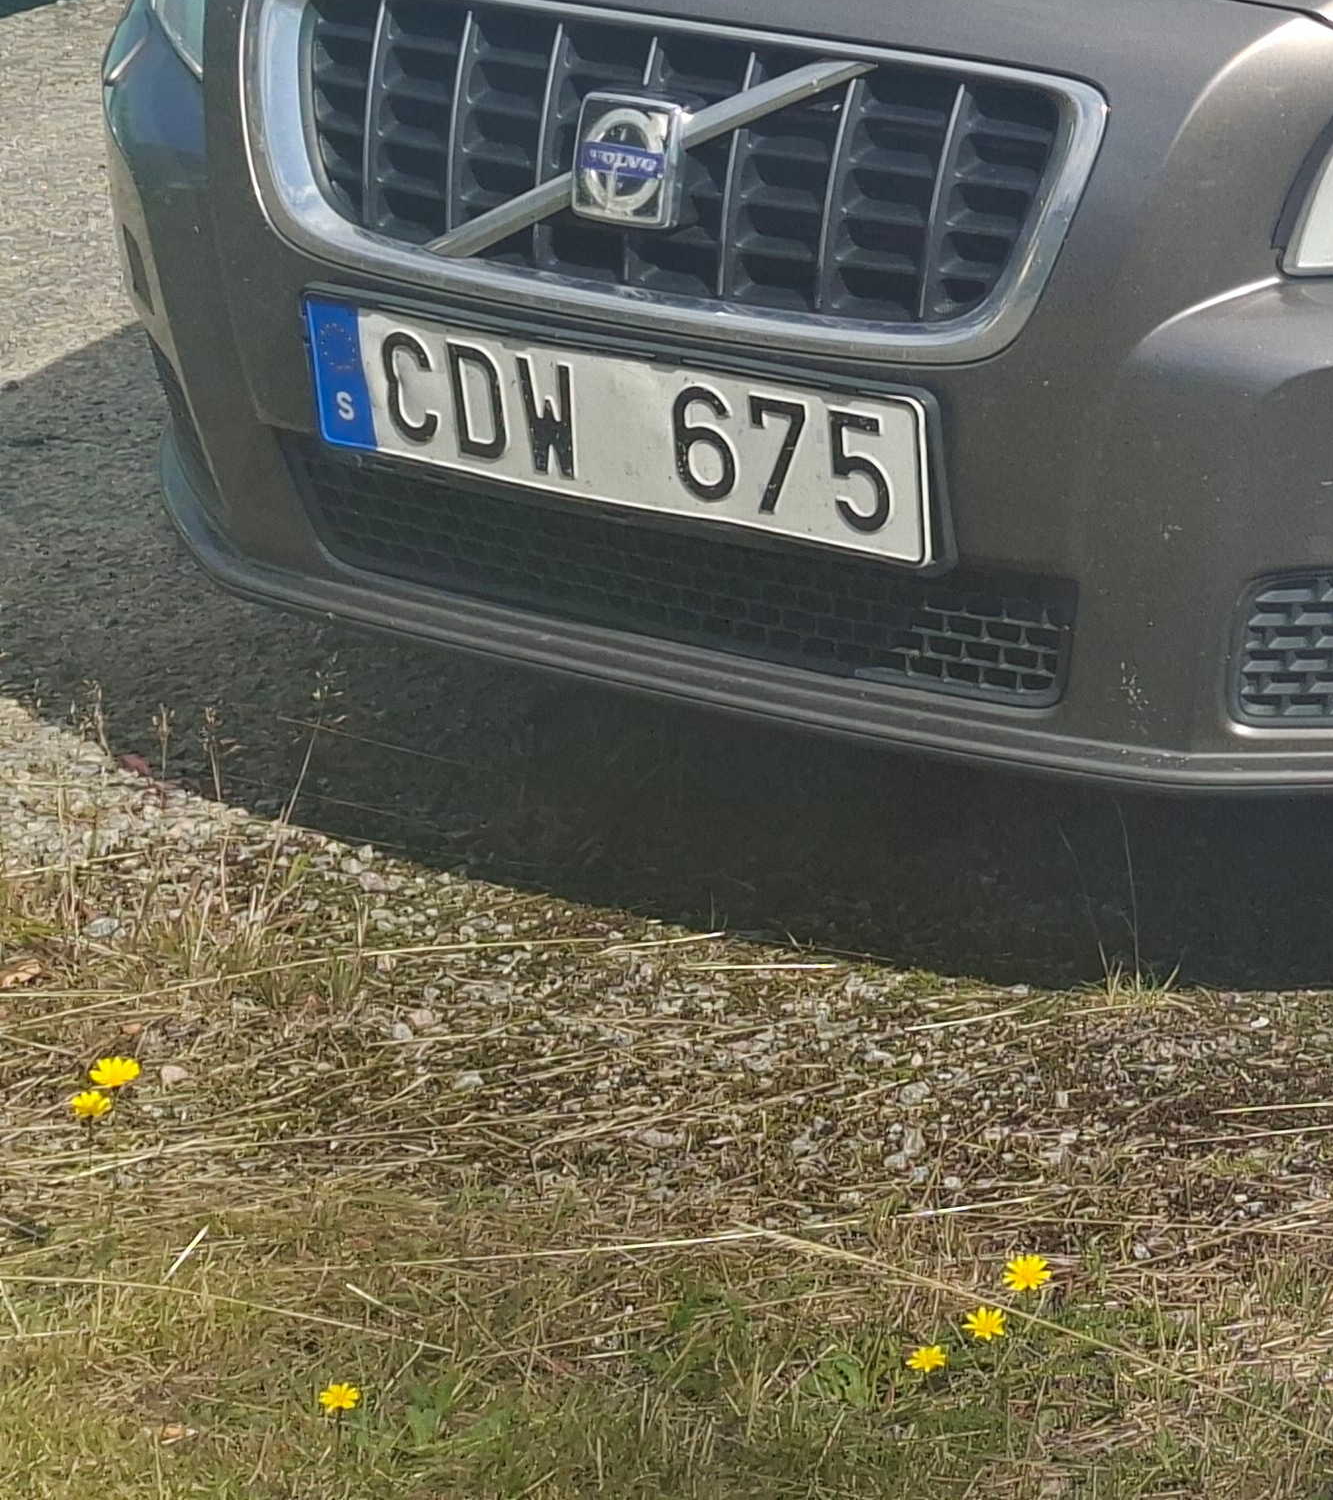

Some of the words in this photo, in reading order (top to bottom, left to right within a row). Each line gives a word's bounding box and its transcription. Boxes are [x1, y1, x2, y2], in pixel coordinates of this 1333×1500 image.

[336, 391, 355, 421] S
[381, 330, 575, 480] CDW
[672, 384, 891, 534] 675
